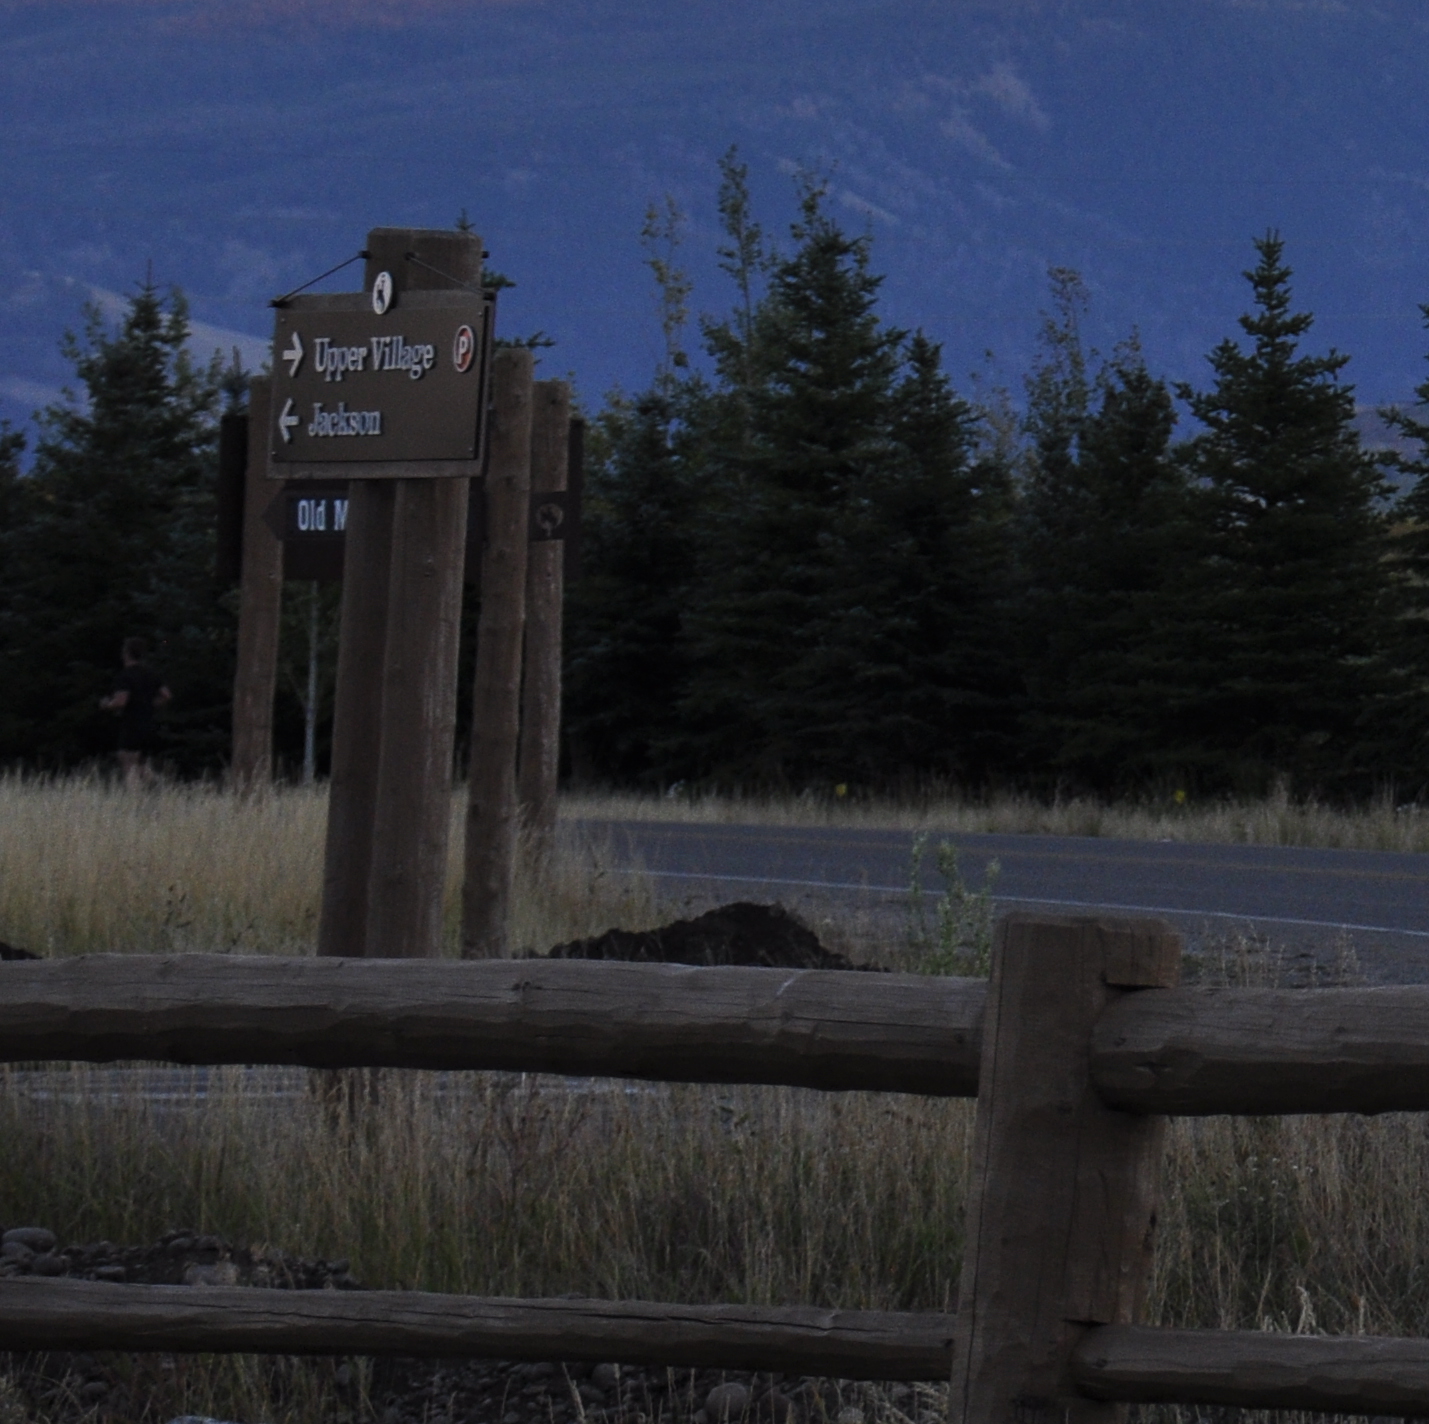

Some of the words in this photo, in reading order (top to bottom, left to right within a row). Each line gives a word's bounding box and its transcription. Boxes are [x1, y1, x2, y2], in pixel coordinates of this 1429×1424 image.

[313, 337, 368, 382] Upper
[370, 335, 435, 380] Village
[308, 402, 382, 437] Jackson
[297, 498, 326, 531] Old
